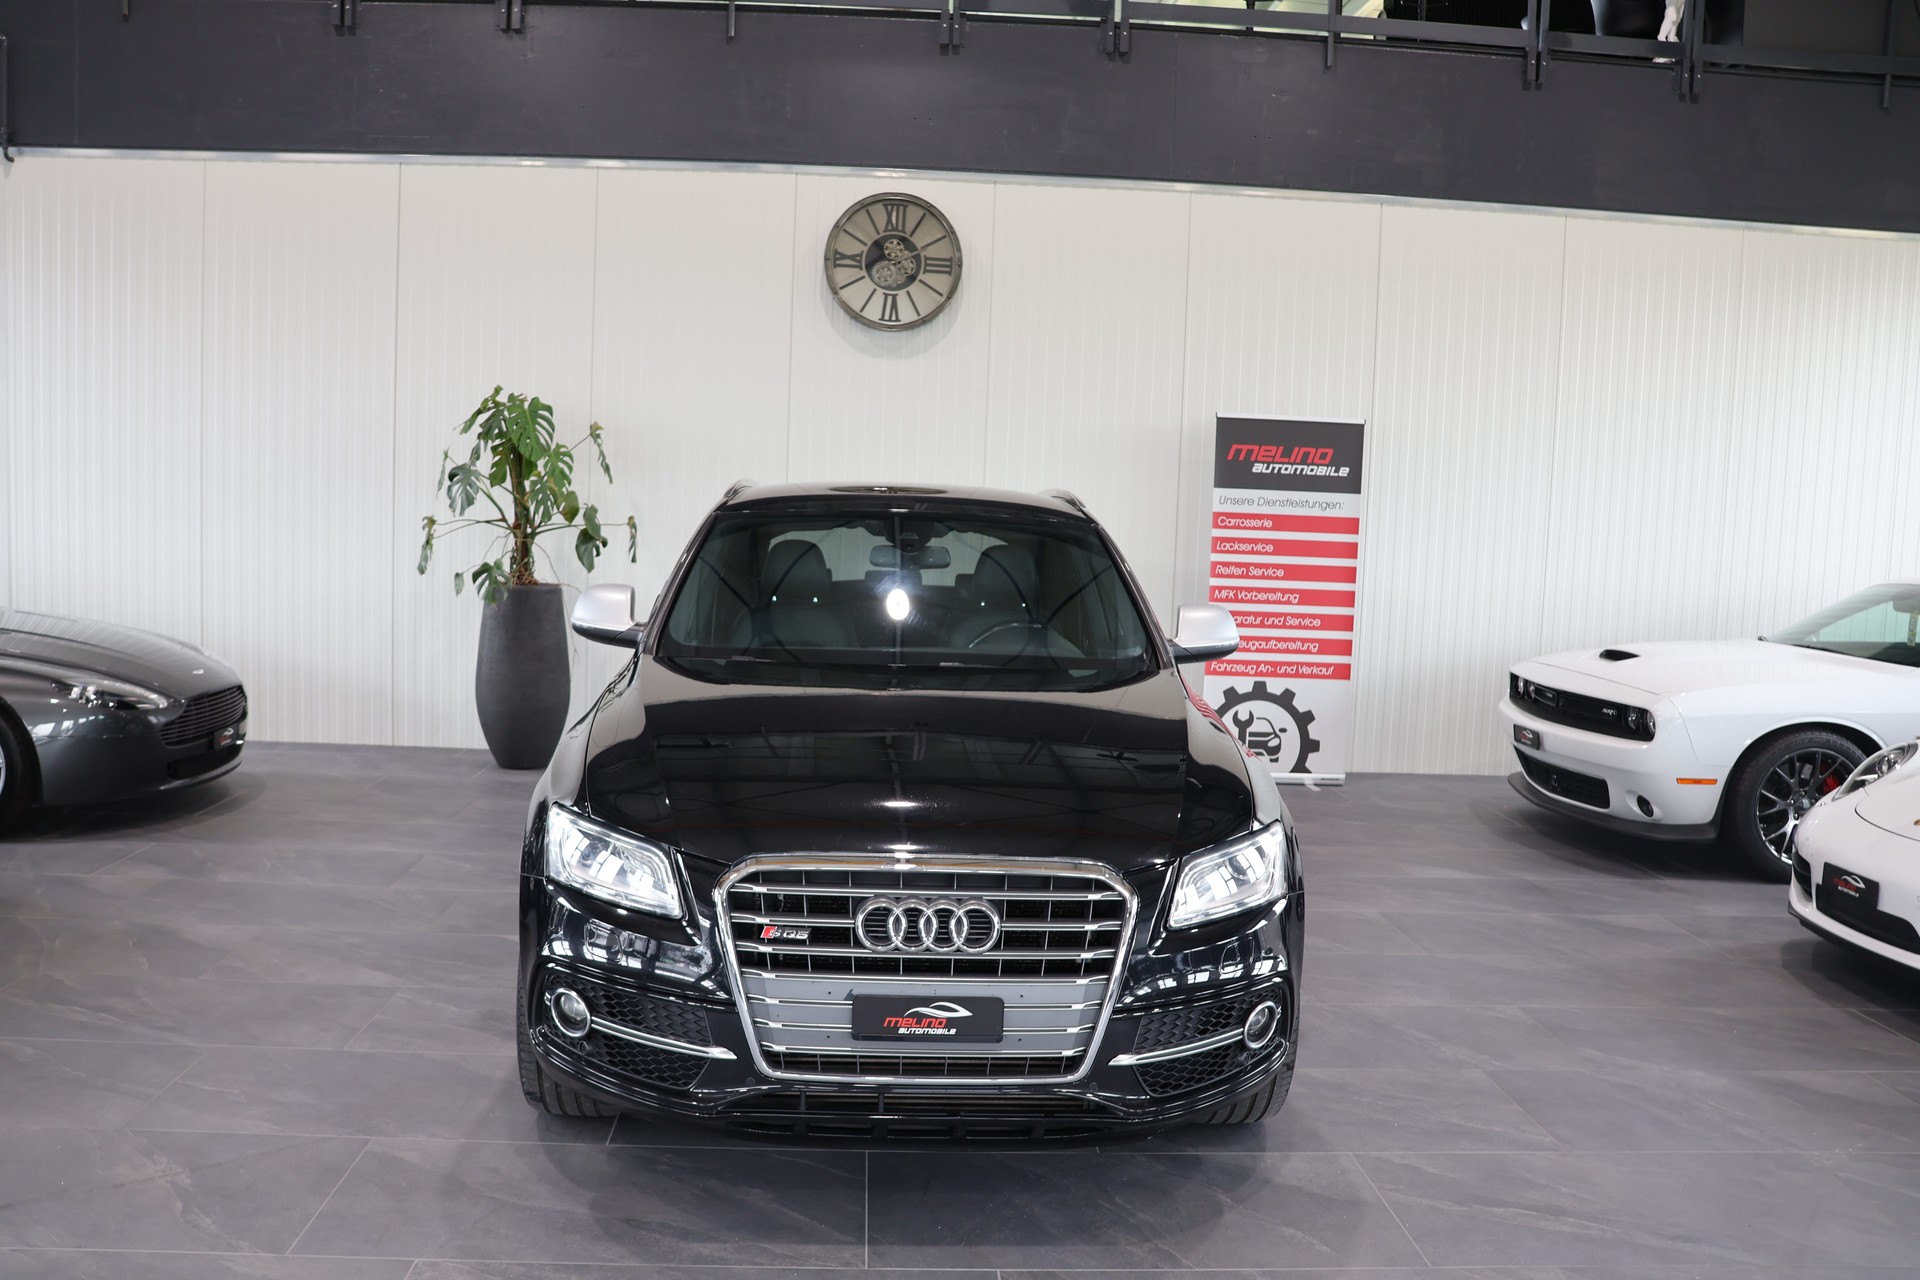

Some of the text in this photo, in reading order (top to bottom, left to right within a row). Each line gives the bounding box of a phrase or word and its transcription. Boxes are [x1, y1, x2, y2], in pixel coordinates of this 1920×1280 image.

[1219, 496, 1344, 512] Unsere Dienstleistungen:
[1218, 516, 1272, 528] Carrosserie
[1216, 541, 1274, 552] Lackservice
[1216, 565, 1284, 577] Reifen Service
[1214, 590, 1300, 604] MFK Vorbereitung
[1234, 614, 1321, 627] aratur und Service
[1238, 639, 1319, 652] eugaufbereitung
[1210, 662, 1334, 676] Fahrzeug An- und Verkauf
